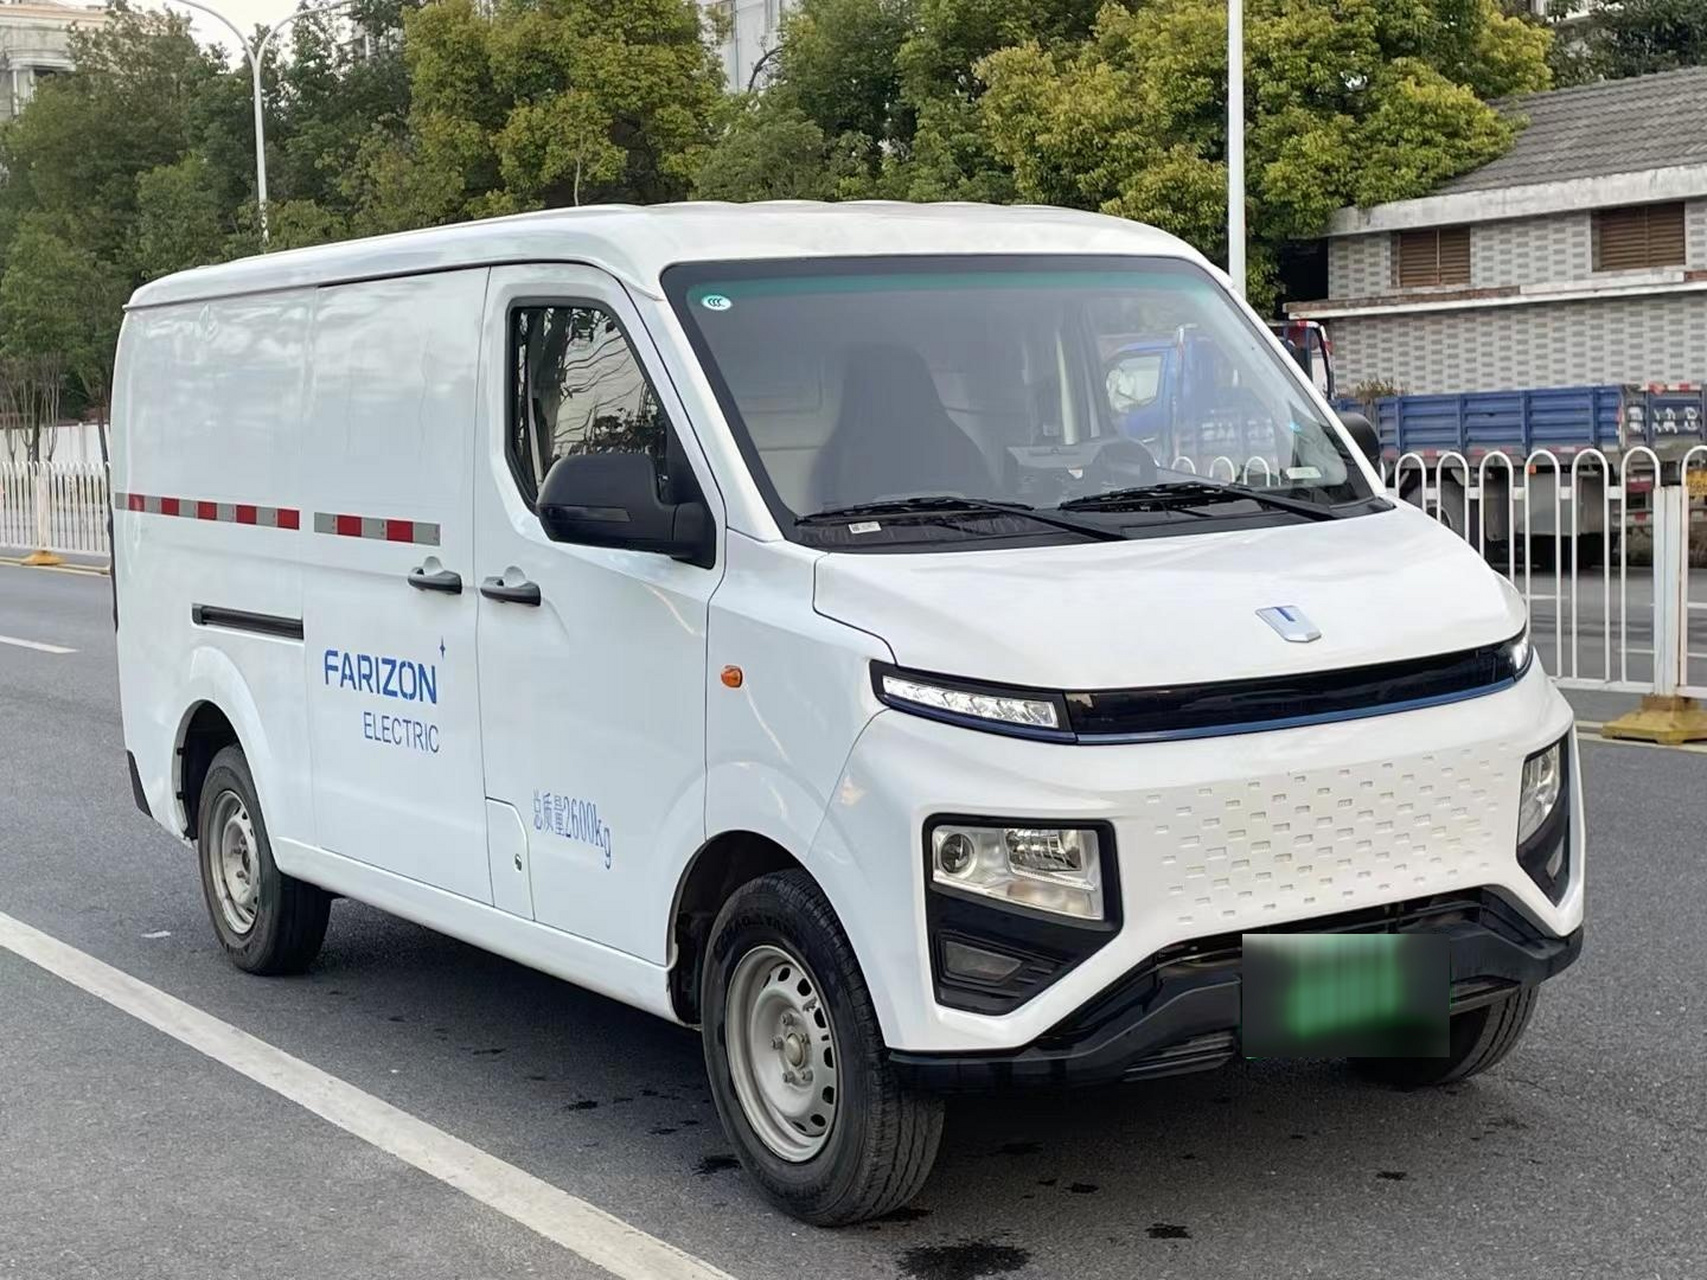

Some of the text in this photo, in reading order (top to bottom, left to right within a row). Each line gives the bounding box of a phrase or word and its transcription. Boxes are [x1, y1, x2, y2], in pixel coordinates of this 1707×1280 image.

[324, 649, 438, 704] FARIZON
[363, 711, 440, 753] ELECTRIC
[533, 787, 612, 870] 总质量2600kg
